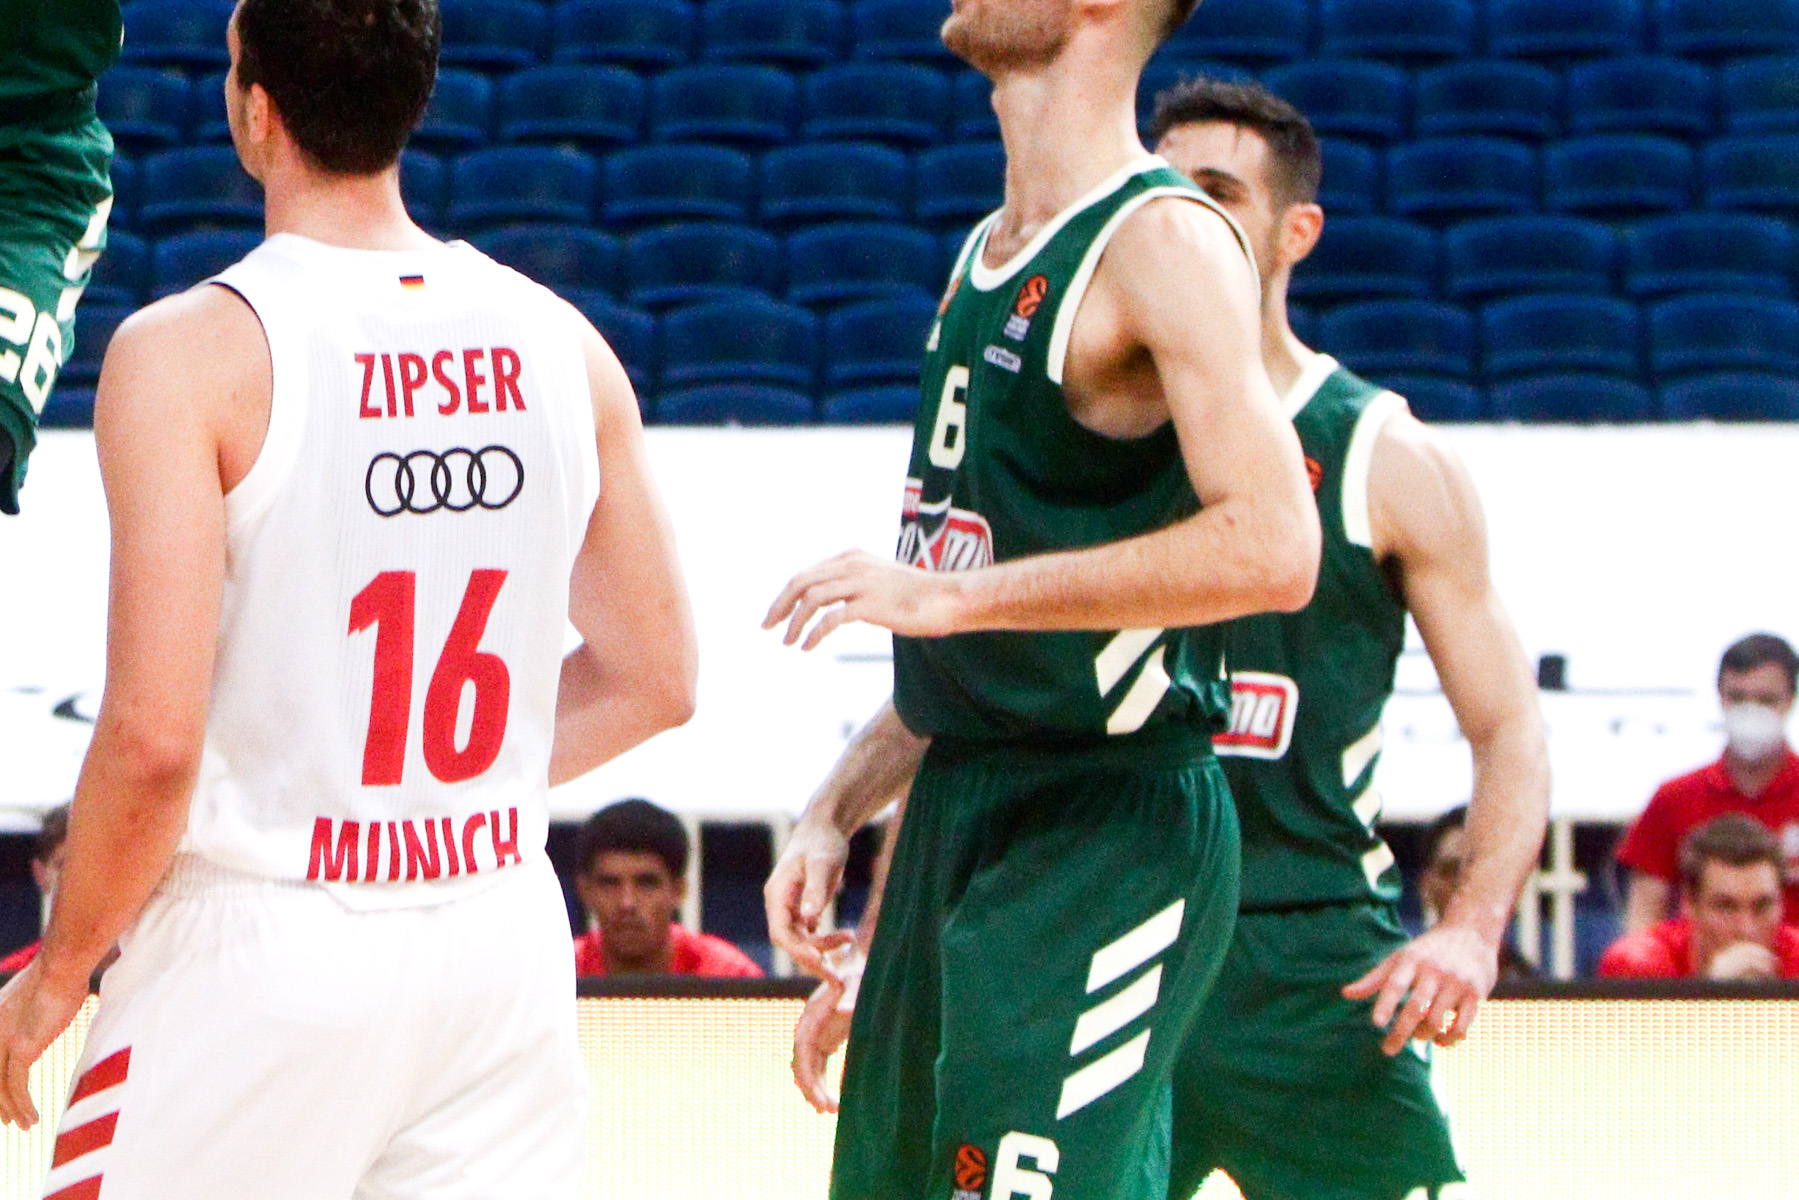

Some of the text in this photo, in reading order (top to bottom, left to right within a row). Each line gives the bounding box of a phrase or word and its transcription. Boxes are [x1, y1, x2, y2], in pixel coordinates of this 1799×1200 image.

[353, 347, 528, 419] ZIPSER
[928, 364, 970, 471] 6
[346, 568, 512, 787] 16
[305, 806, 523, 884] MUNICH
